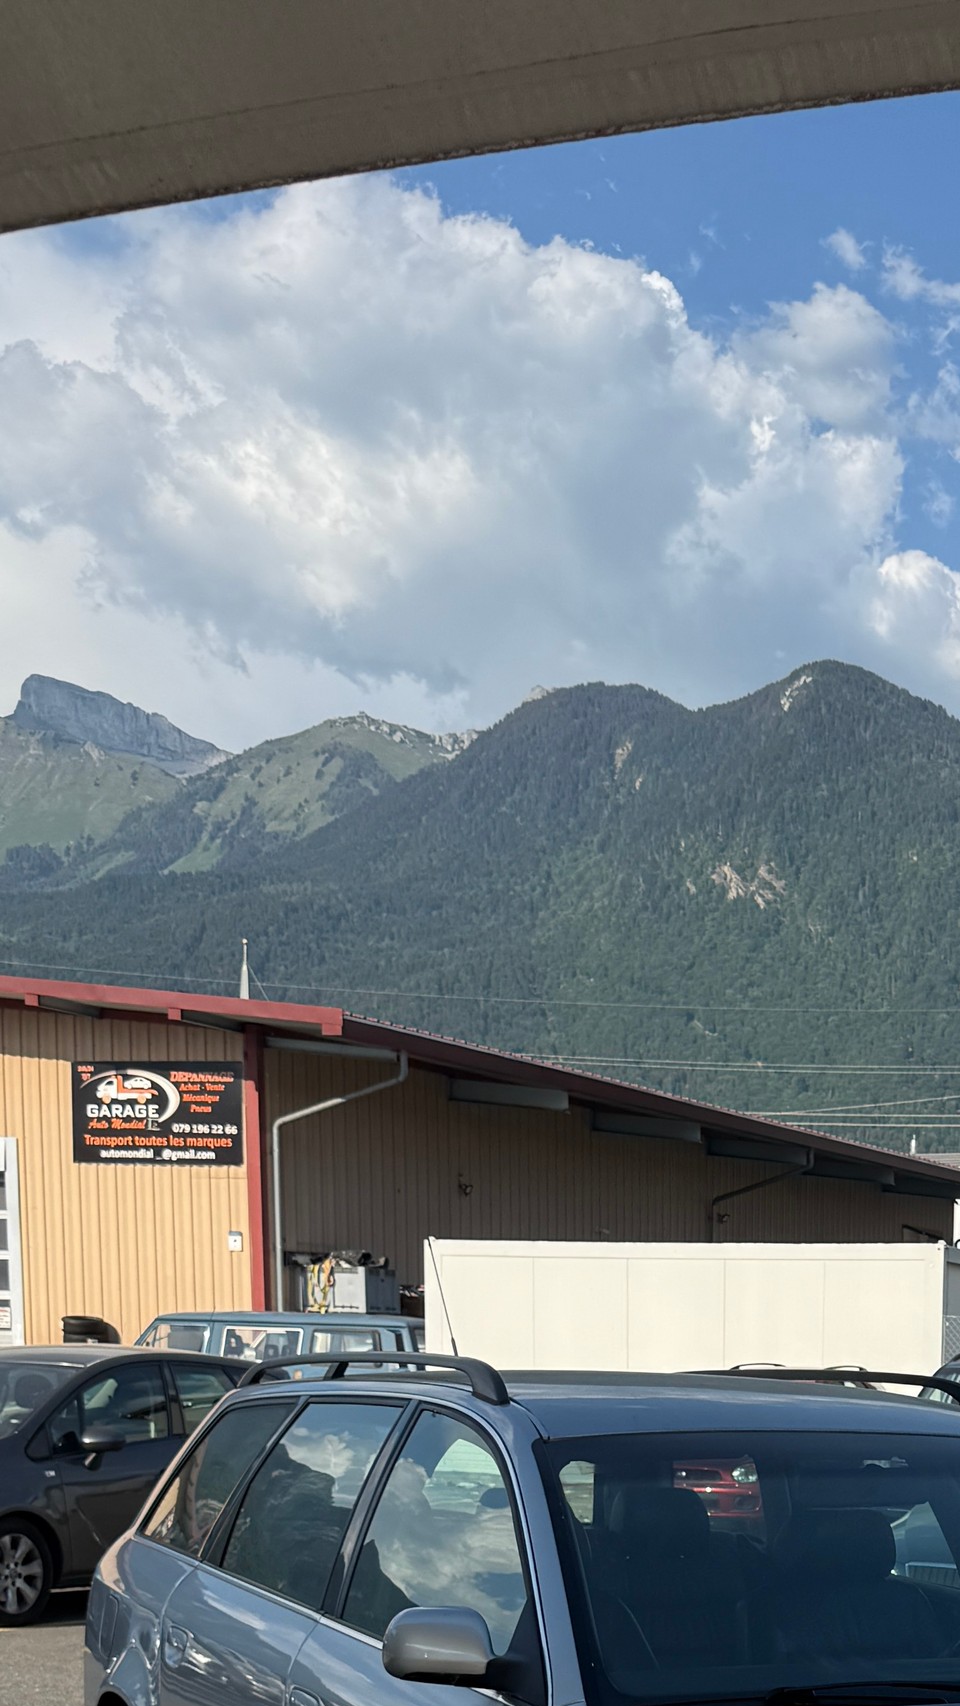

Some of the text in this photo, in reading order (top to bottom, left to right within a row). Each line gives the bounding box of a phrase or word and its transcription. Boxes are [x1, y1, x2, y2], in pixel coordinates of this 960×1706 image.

[179, 1083, 200, 1091] Achat
[205, 1083, 225, 1091] Vente
[182, 1093, 220, 1103] Mécanique
[86, 1104, 159, 1118] GARAGE
[190, 1104, 212, 1113] Pneus
[88, 1118, 109, 1129] Auto
[111, 1118, 147, 1130] Mondial
[171, 1122, 238, 1135] 079 196 22 66
[84, 1134, 233, 1149] Transport toutes les marques
